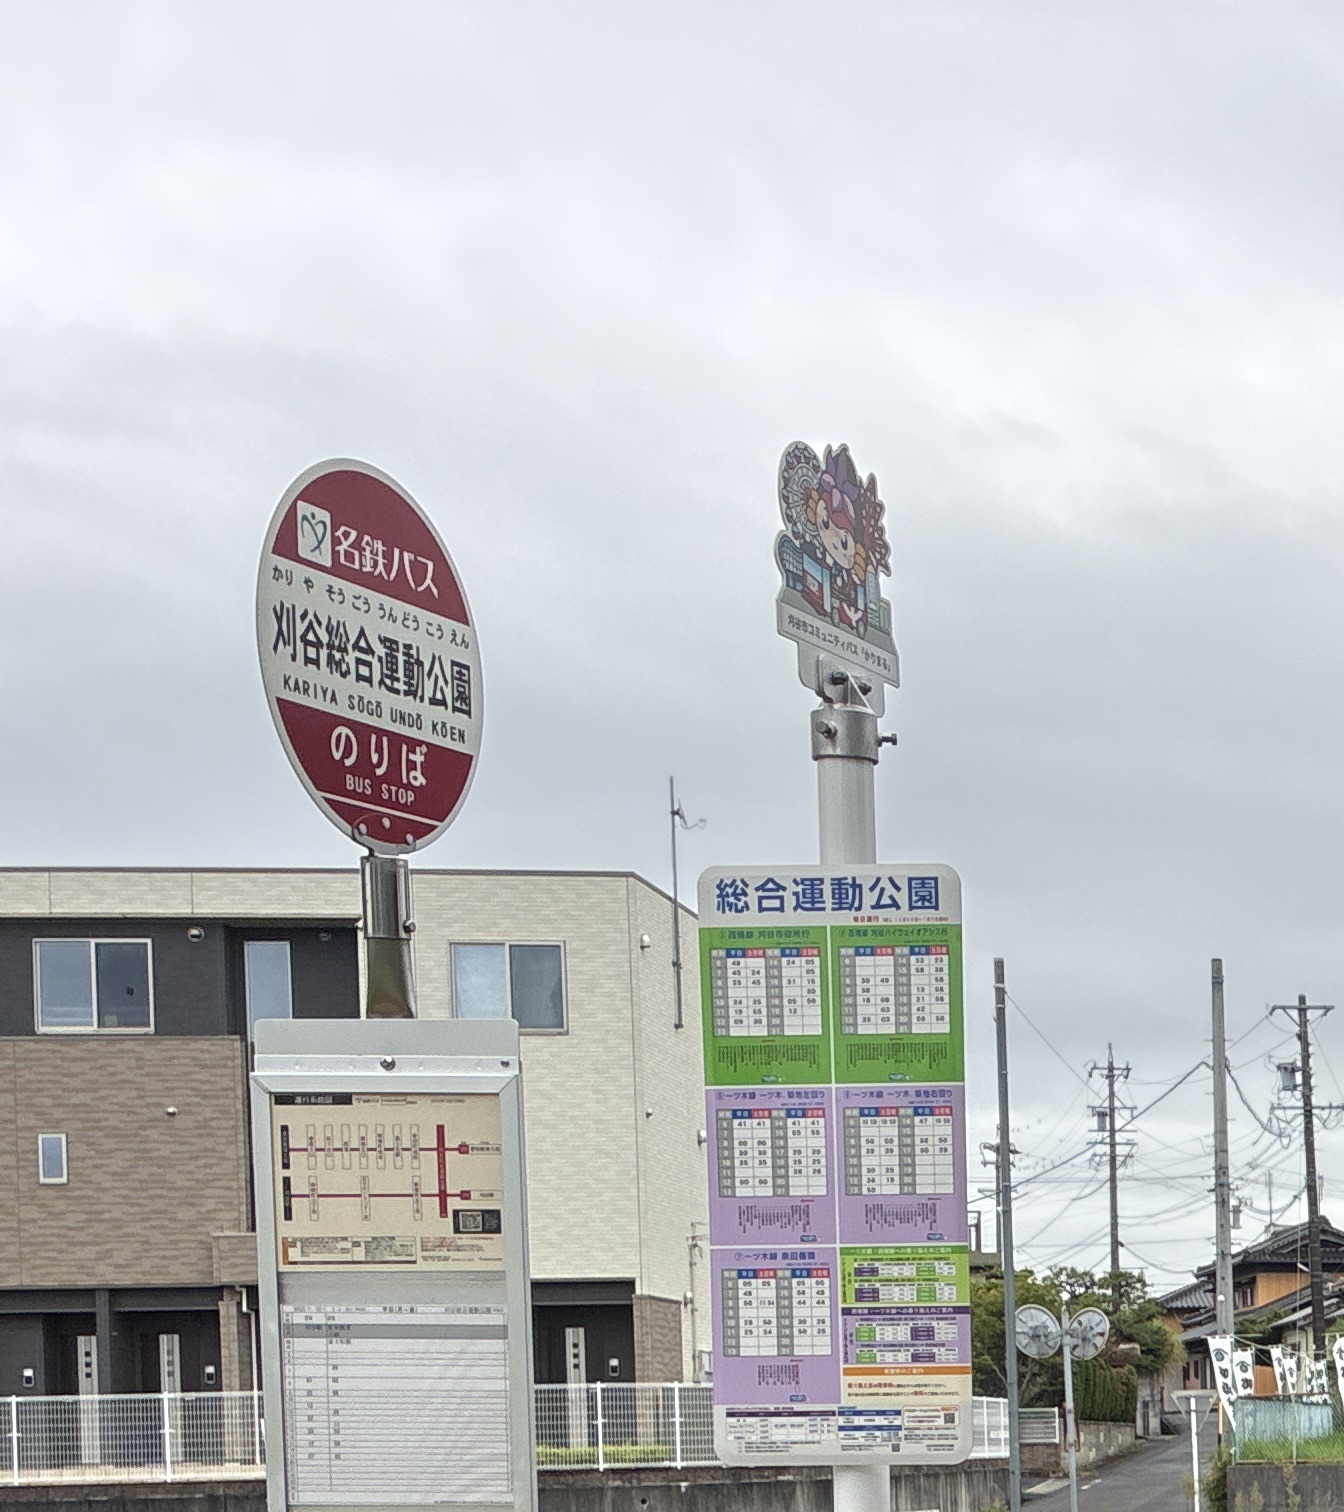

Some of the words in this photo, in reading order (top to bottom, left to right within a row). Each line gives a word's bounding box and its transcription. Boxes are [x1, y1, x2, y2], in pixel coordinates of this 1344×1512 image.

[334, 525, 439, 599] 名鉄バス
[272, 600, 472, 719] 刈谷総合運動公園
[283, 673, 338, 706] KARIYA
[330, 725, 427, 787] のりば
[345, 774, 372, 796] BUS
[381, 783, 415, 806] STOP
[715, 876, 940, 915] 総合運動公園
[791, 1119, 801, 1127] 41
[810, 1119, 820, 1127] 41
